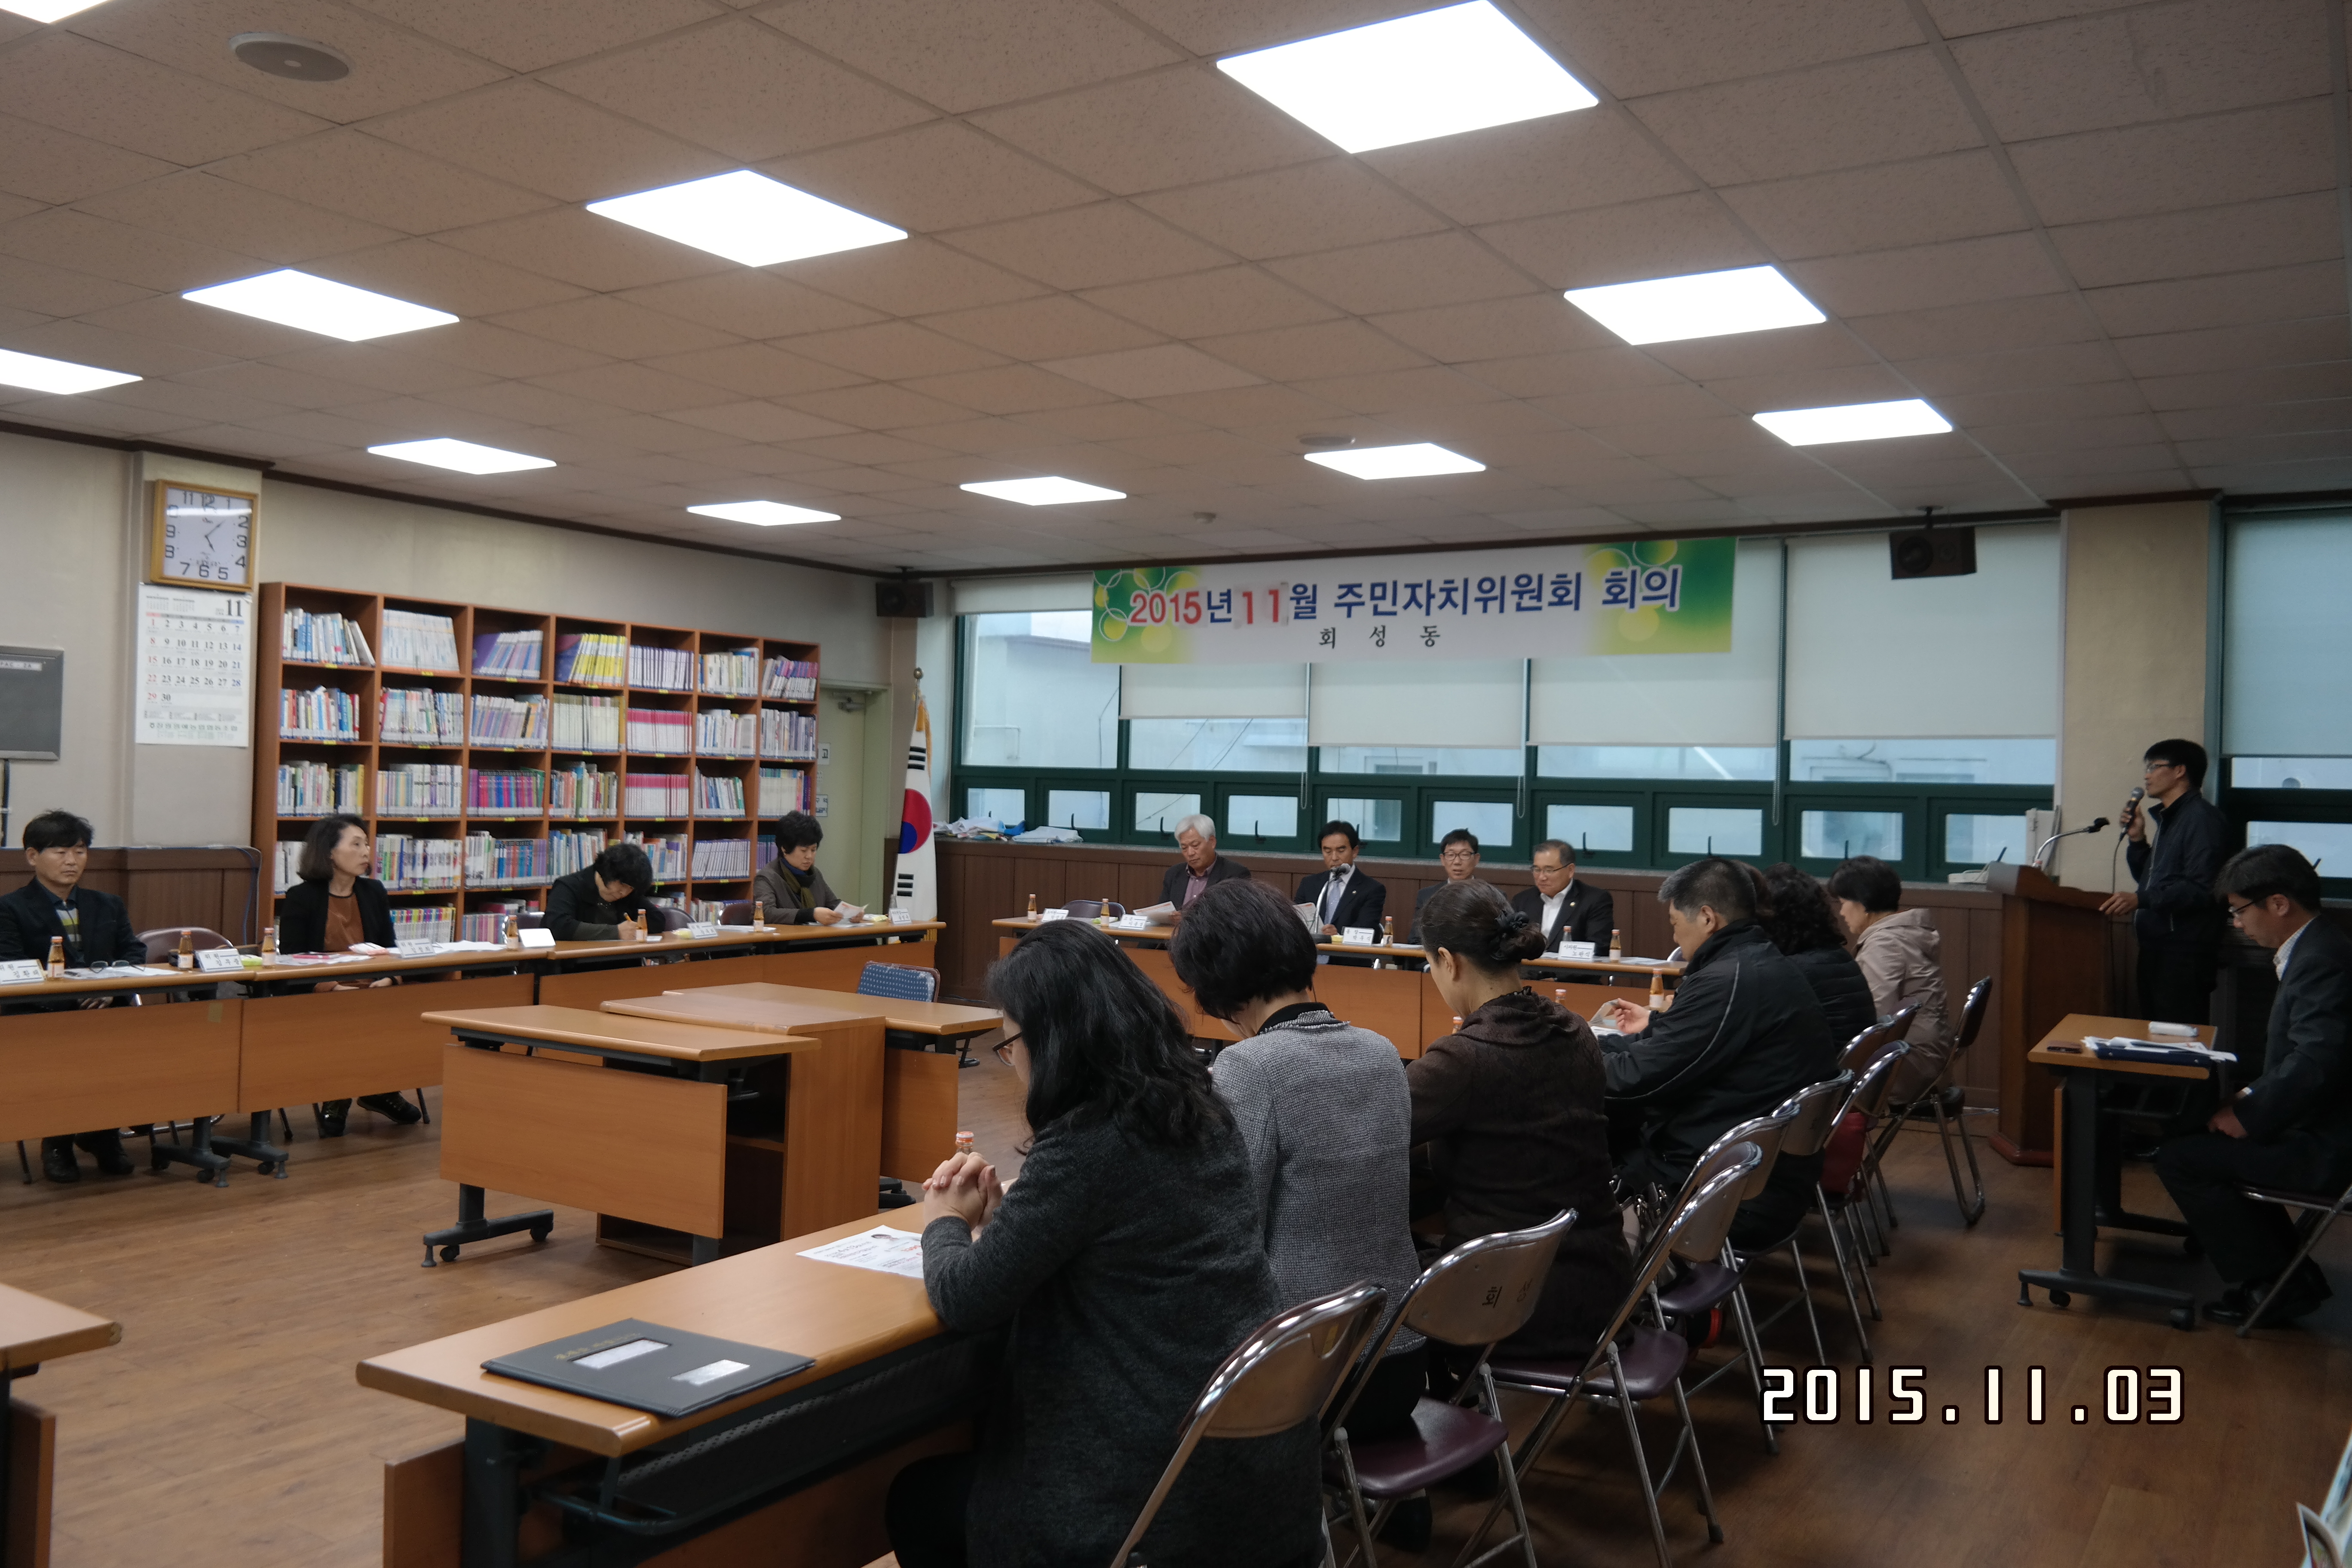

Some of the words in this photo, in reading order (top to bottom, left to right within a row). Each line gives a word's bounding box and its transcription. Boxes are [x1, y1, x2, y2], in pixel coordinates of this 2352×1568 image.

[184, 491, 193, 505] 11
[201, 493, 215, 510] 12
[227, 497, 231, 509] 1
[239, 516, 248, 528] 2
[166, 525, 175, 538] 9
[237, 535, 247, 548] 3
[165, 545, 175, 558] 8
[181, 562, 190, 575] 7
[236, 556, 245, 568] 4
[199, 565, 209, 577] 6
[218, 567, 228, 580] 5
[1130, 587, 1234, 627] 2015년
[1240, 582, 1320, 627] 11월
[1333, 573, 1582, 619] 주민자치위원회
[1601, 565, 1681, 610] 회의
[227, 598, 242, 617] 11
